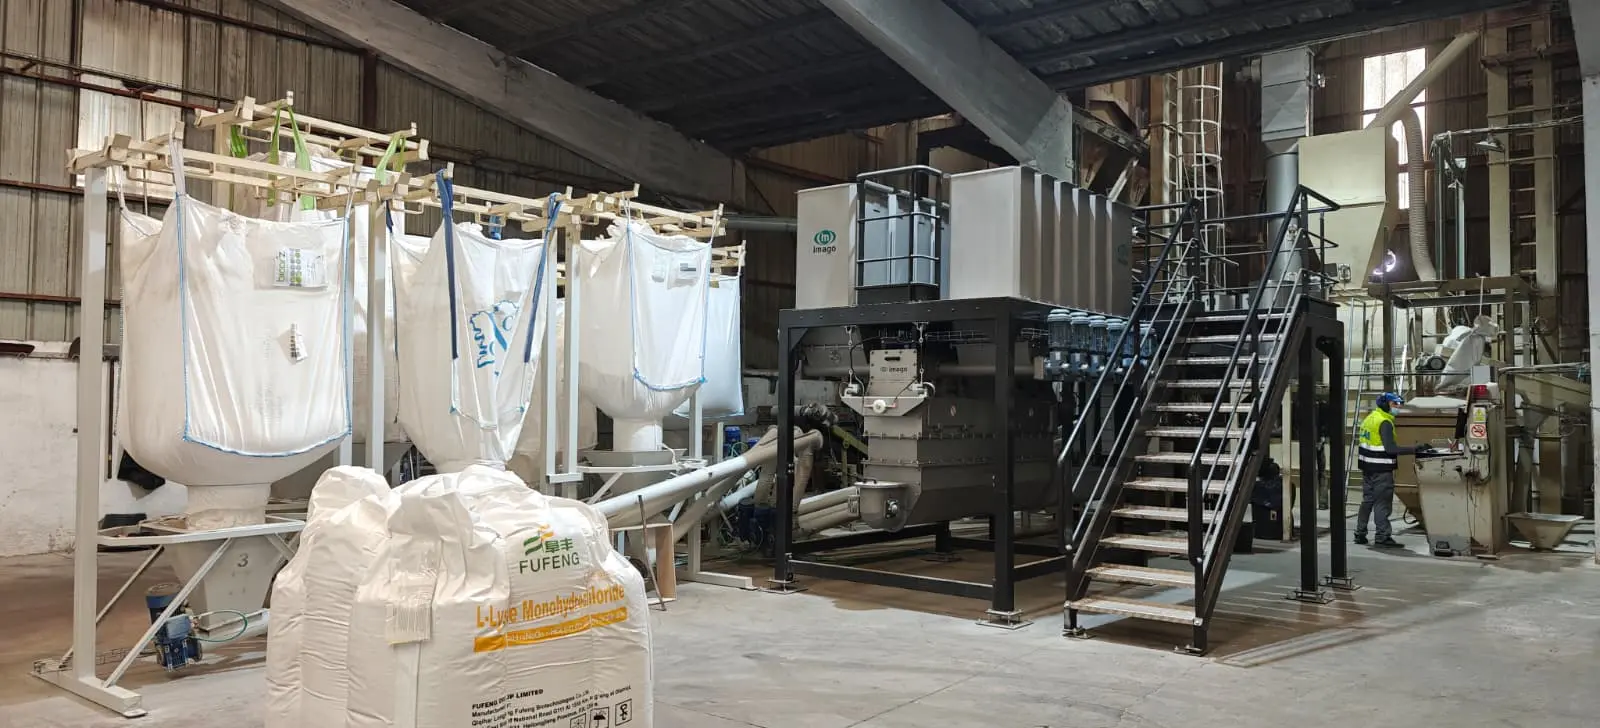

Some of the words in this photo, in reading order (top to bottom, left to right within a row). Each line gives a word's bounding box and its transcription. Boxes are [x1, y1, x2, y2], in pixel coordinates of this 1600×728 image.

[813, 245, 837, 254] imago
[544, 537, 575, 553] 阜丰
[236, 553, 249, 568] 3
[519, 551, 580, 574] FUFENG
[472, 700, 499, 710] FUFENG
[515, 688, 544, 699] LIMITED
